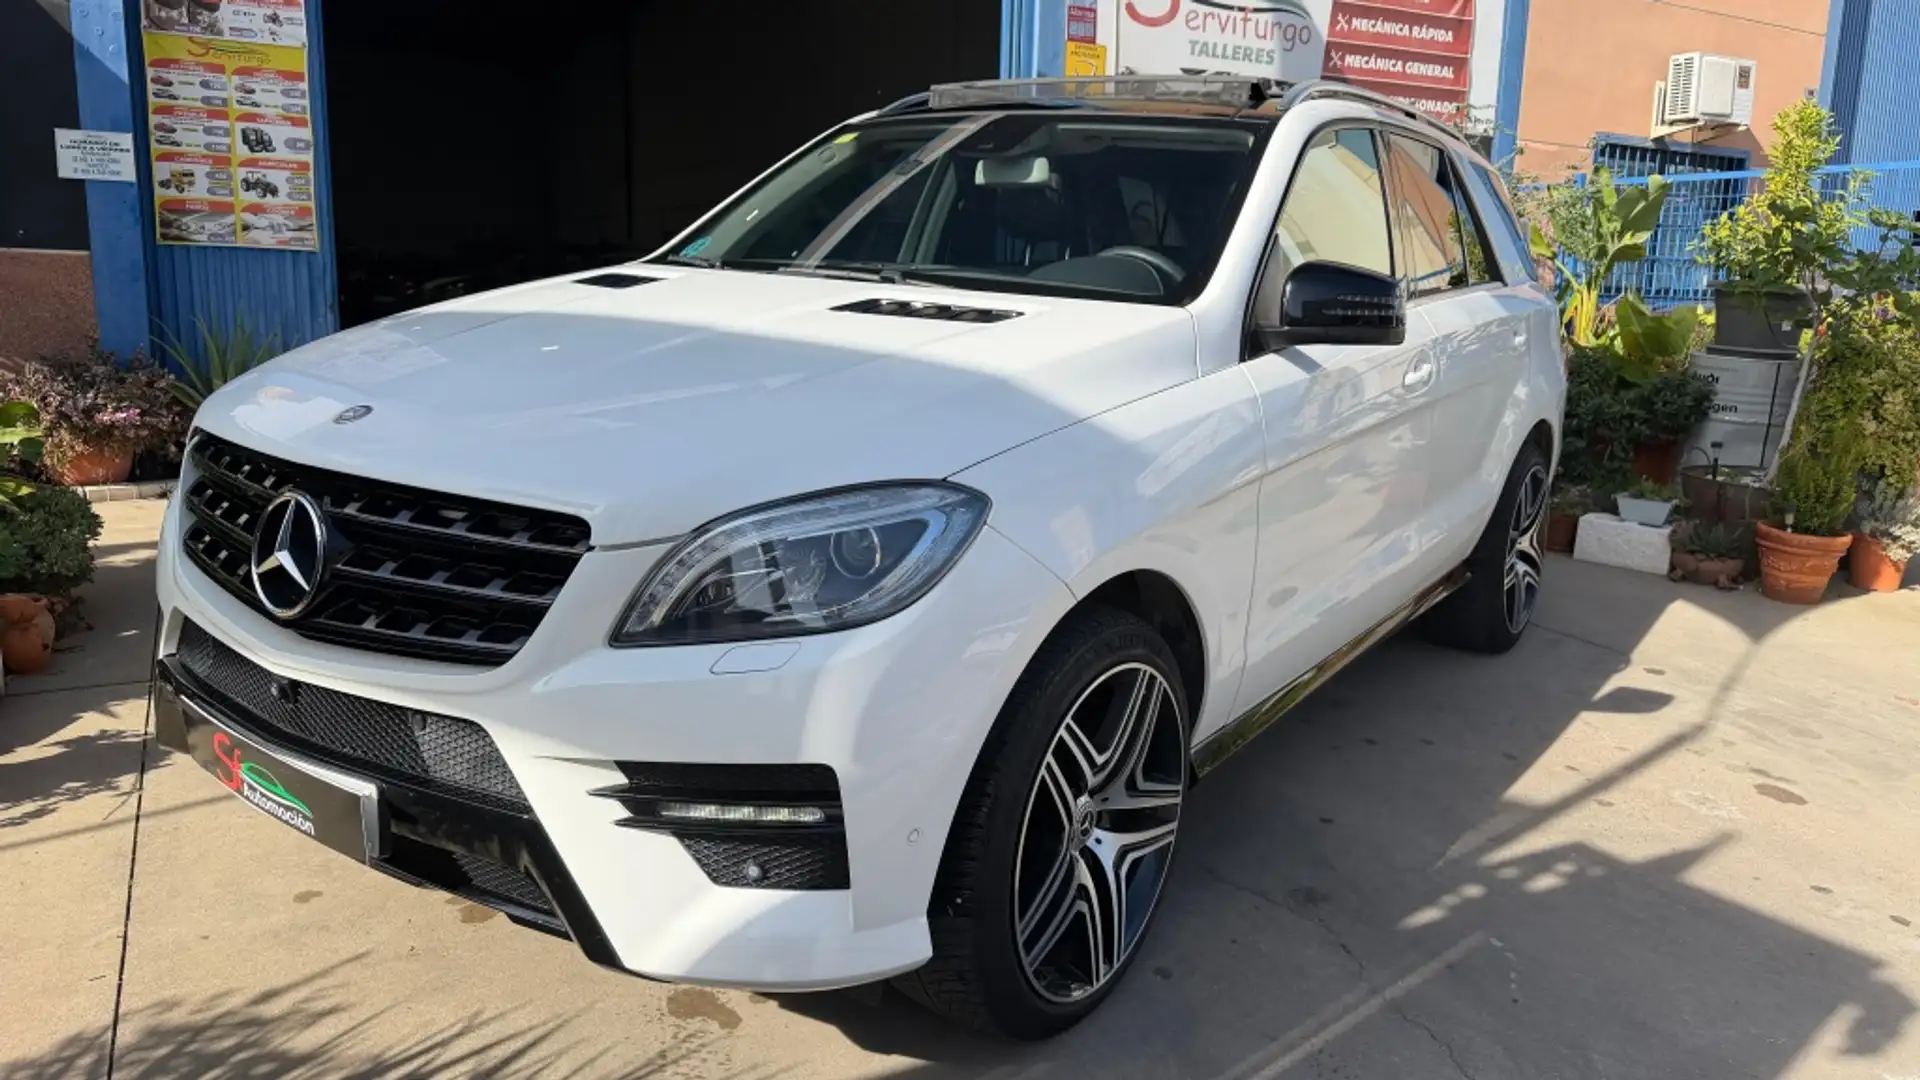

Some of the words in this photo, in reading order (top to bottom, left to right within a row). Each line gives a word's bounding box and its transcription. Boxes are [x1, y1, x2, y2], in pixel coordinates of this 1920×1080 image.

[1350, 17, 1409, 37] MECÁNICA
[1411, 25, 1454, 43] RÁPIDA
[1188, 40, 1277, 65] TALLERES
[1343, 53, 1403, 73] MECÁNICA
[1405, 61, 1454, 79] GENERAL
